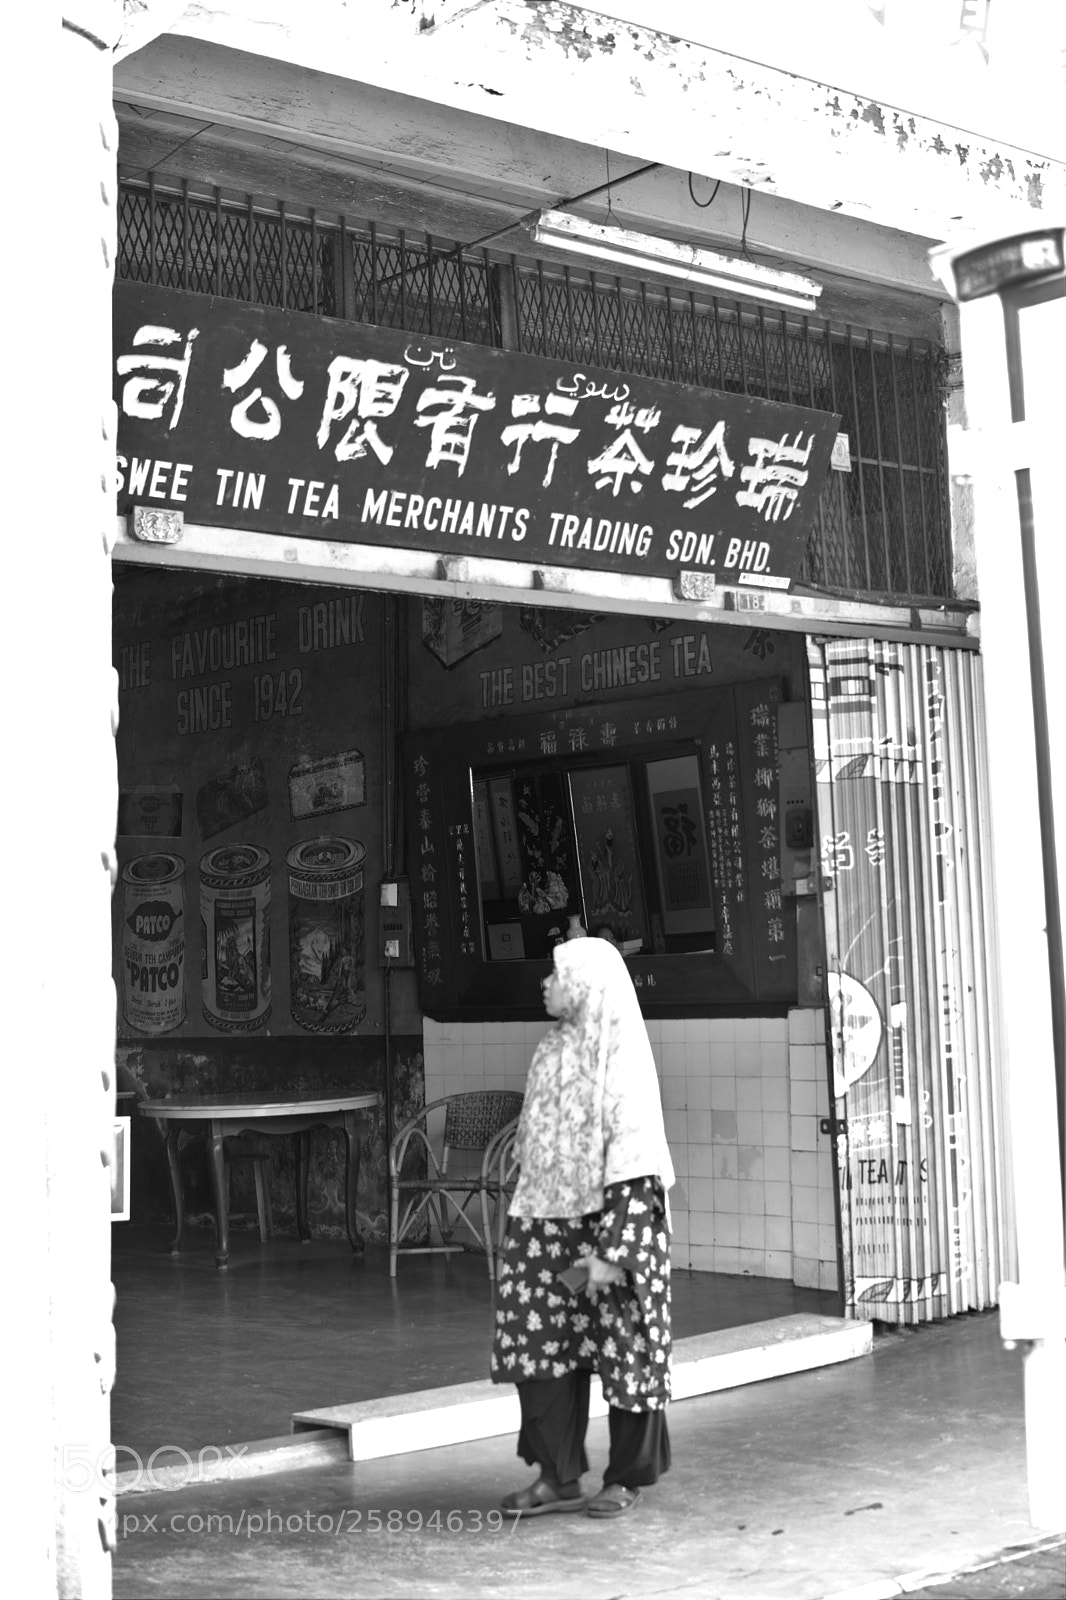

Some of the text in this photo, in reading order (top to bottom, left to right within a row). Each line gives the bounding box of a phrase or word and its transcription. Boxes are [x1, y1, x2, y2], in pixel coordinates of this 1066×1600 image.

[116, 455, 771, 573] SWEE TIN TEA MERCHANTS TRADING SDN. BHD.
[121, 594, 365, 690] THE FAVOURITE DRINK
[479, 667, 514, 709] THE
[522, 656, 571, 703] BEST
[581, 641, 662, 693] CHINESE
[670, 632, 714, 679] TEA
[177, 668, 303, 736] SINCE 1942
[135, 915, 170, 934] PATCO
[144, 953, 156, 965] TEH
